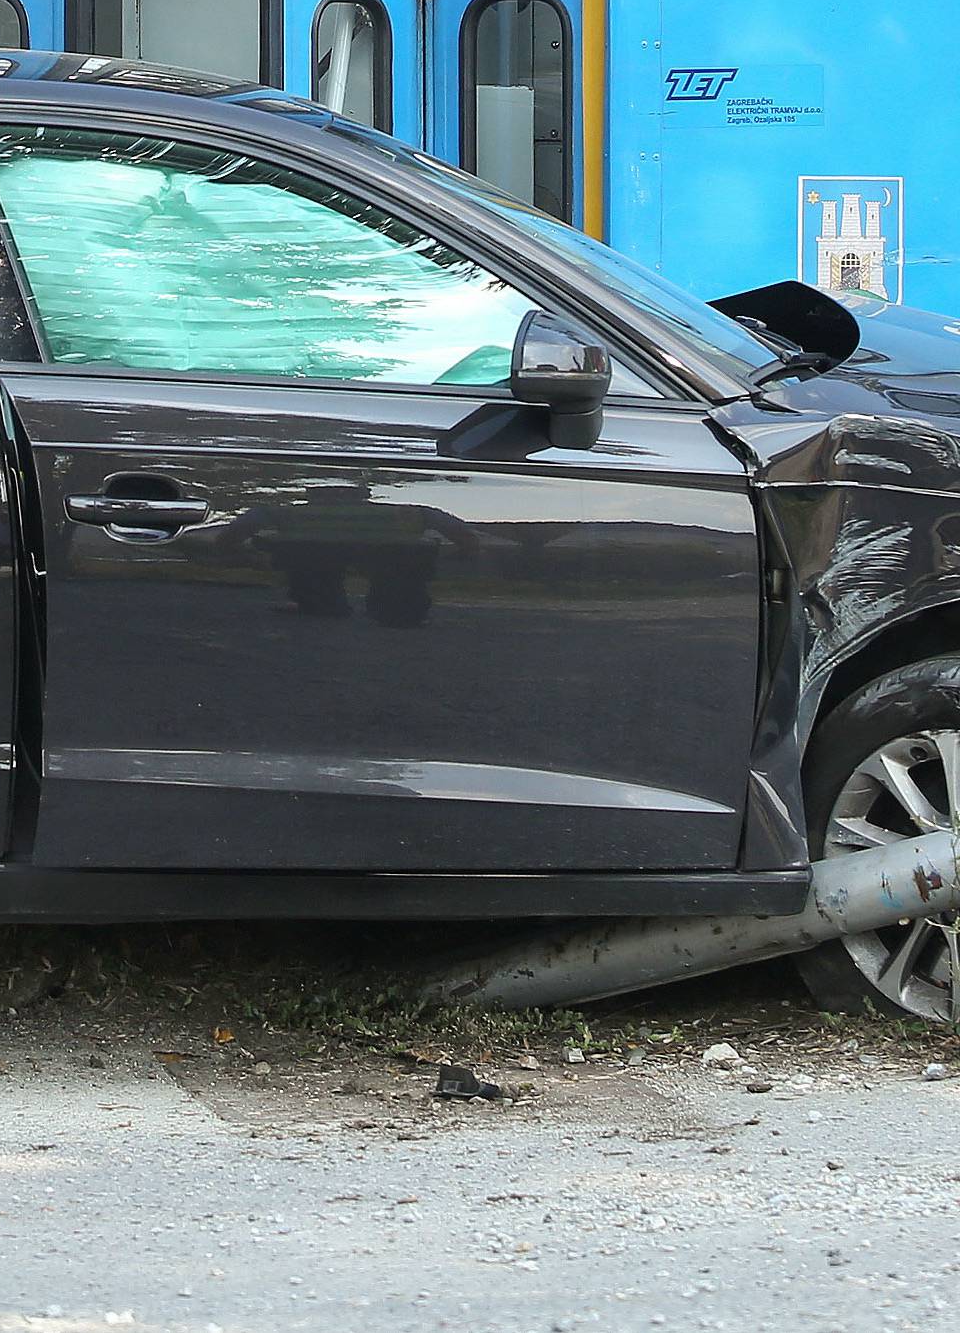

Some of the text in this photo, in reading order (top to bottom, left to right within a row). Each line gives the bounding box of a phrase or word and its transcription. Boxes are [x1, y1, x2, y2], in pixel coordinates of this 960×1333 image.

[665, 68, 738, 101] ZET
[726, 97, 773, 106] ZAGREBAČKI
[727, 106, 769, 115] ELEKTRIČNI
[770, 107, 803, 115] TRAMVAJ
[783, 115, 796, 123] 105
